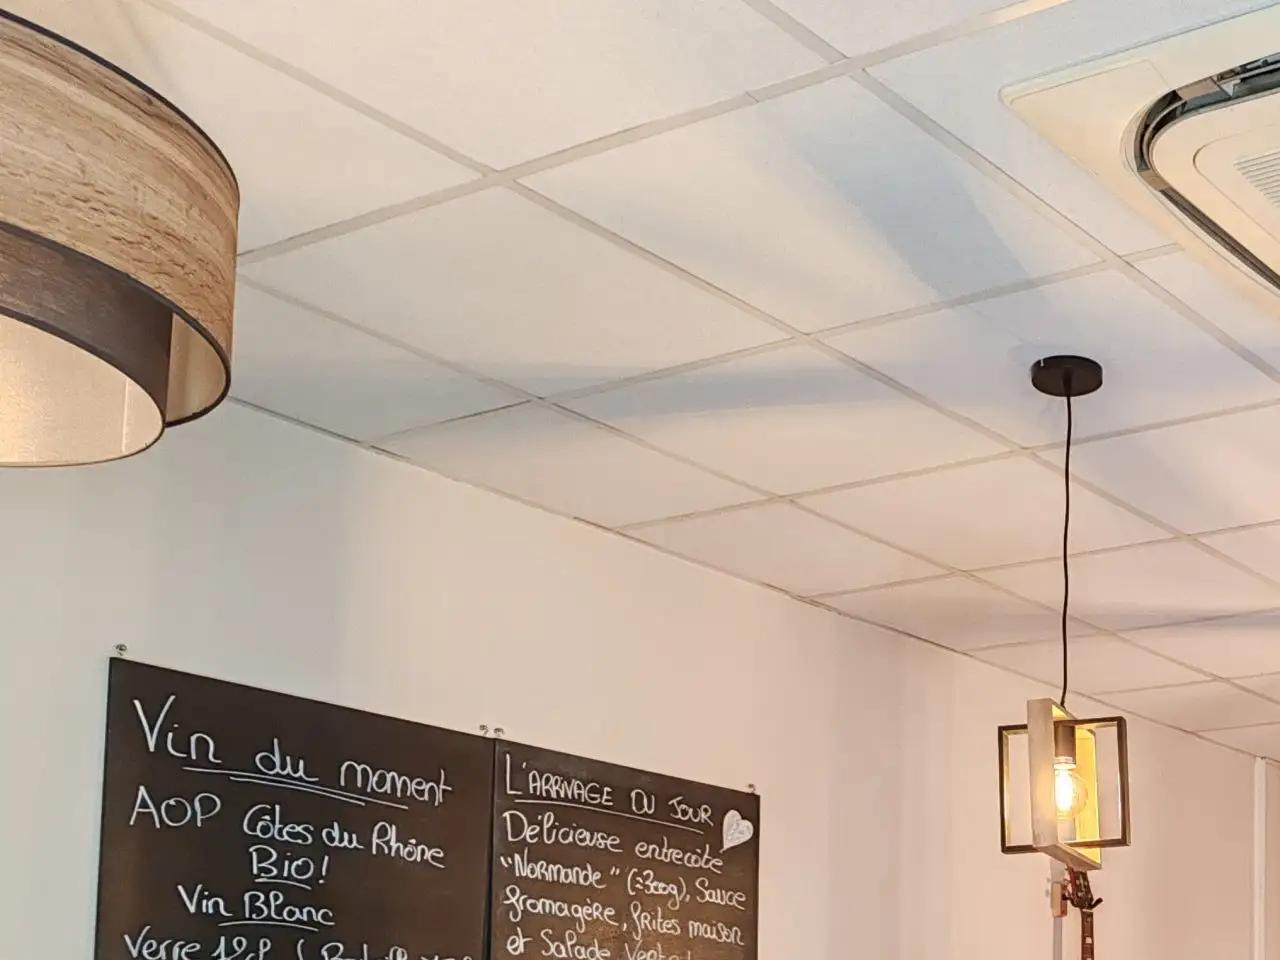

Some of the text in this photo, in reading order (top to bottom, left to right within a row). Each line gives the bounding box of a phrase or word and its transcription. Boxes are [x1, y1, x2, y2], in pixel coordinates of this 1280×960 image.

[133, 695, 453, 807] Vin du moment
[129, 785, 446, 868] AOP Côtes du Rhône
[502, 810, 623, 853] Délicieuse
[668, 796, 714, 827] JOUR
[176, 884, 335, 926] Vin Blanc
[506, 929, 533, 955] et
[689, 920, 746, 946] maison
